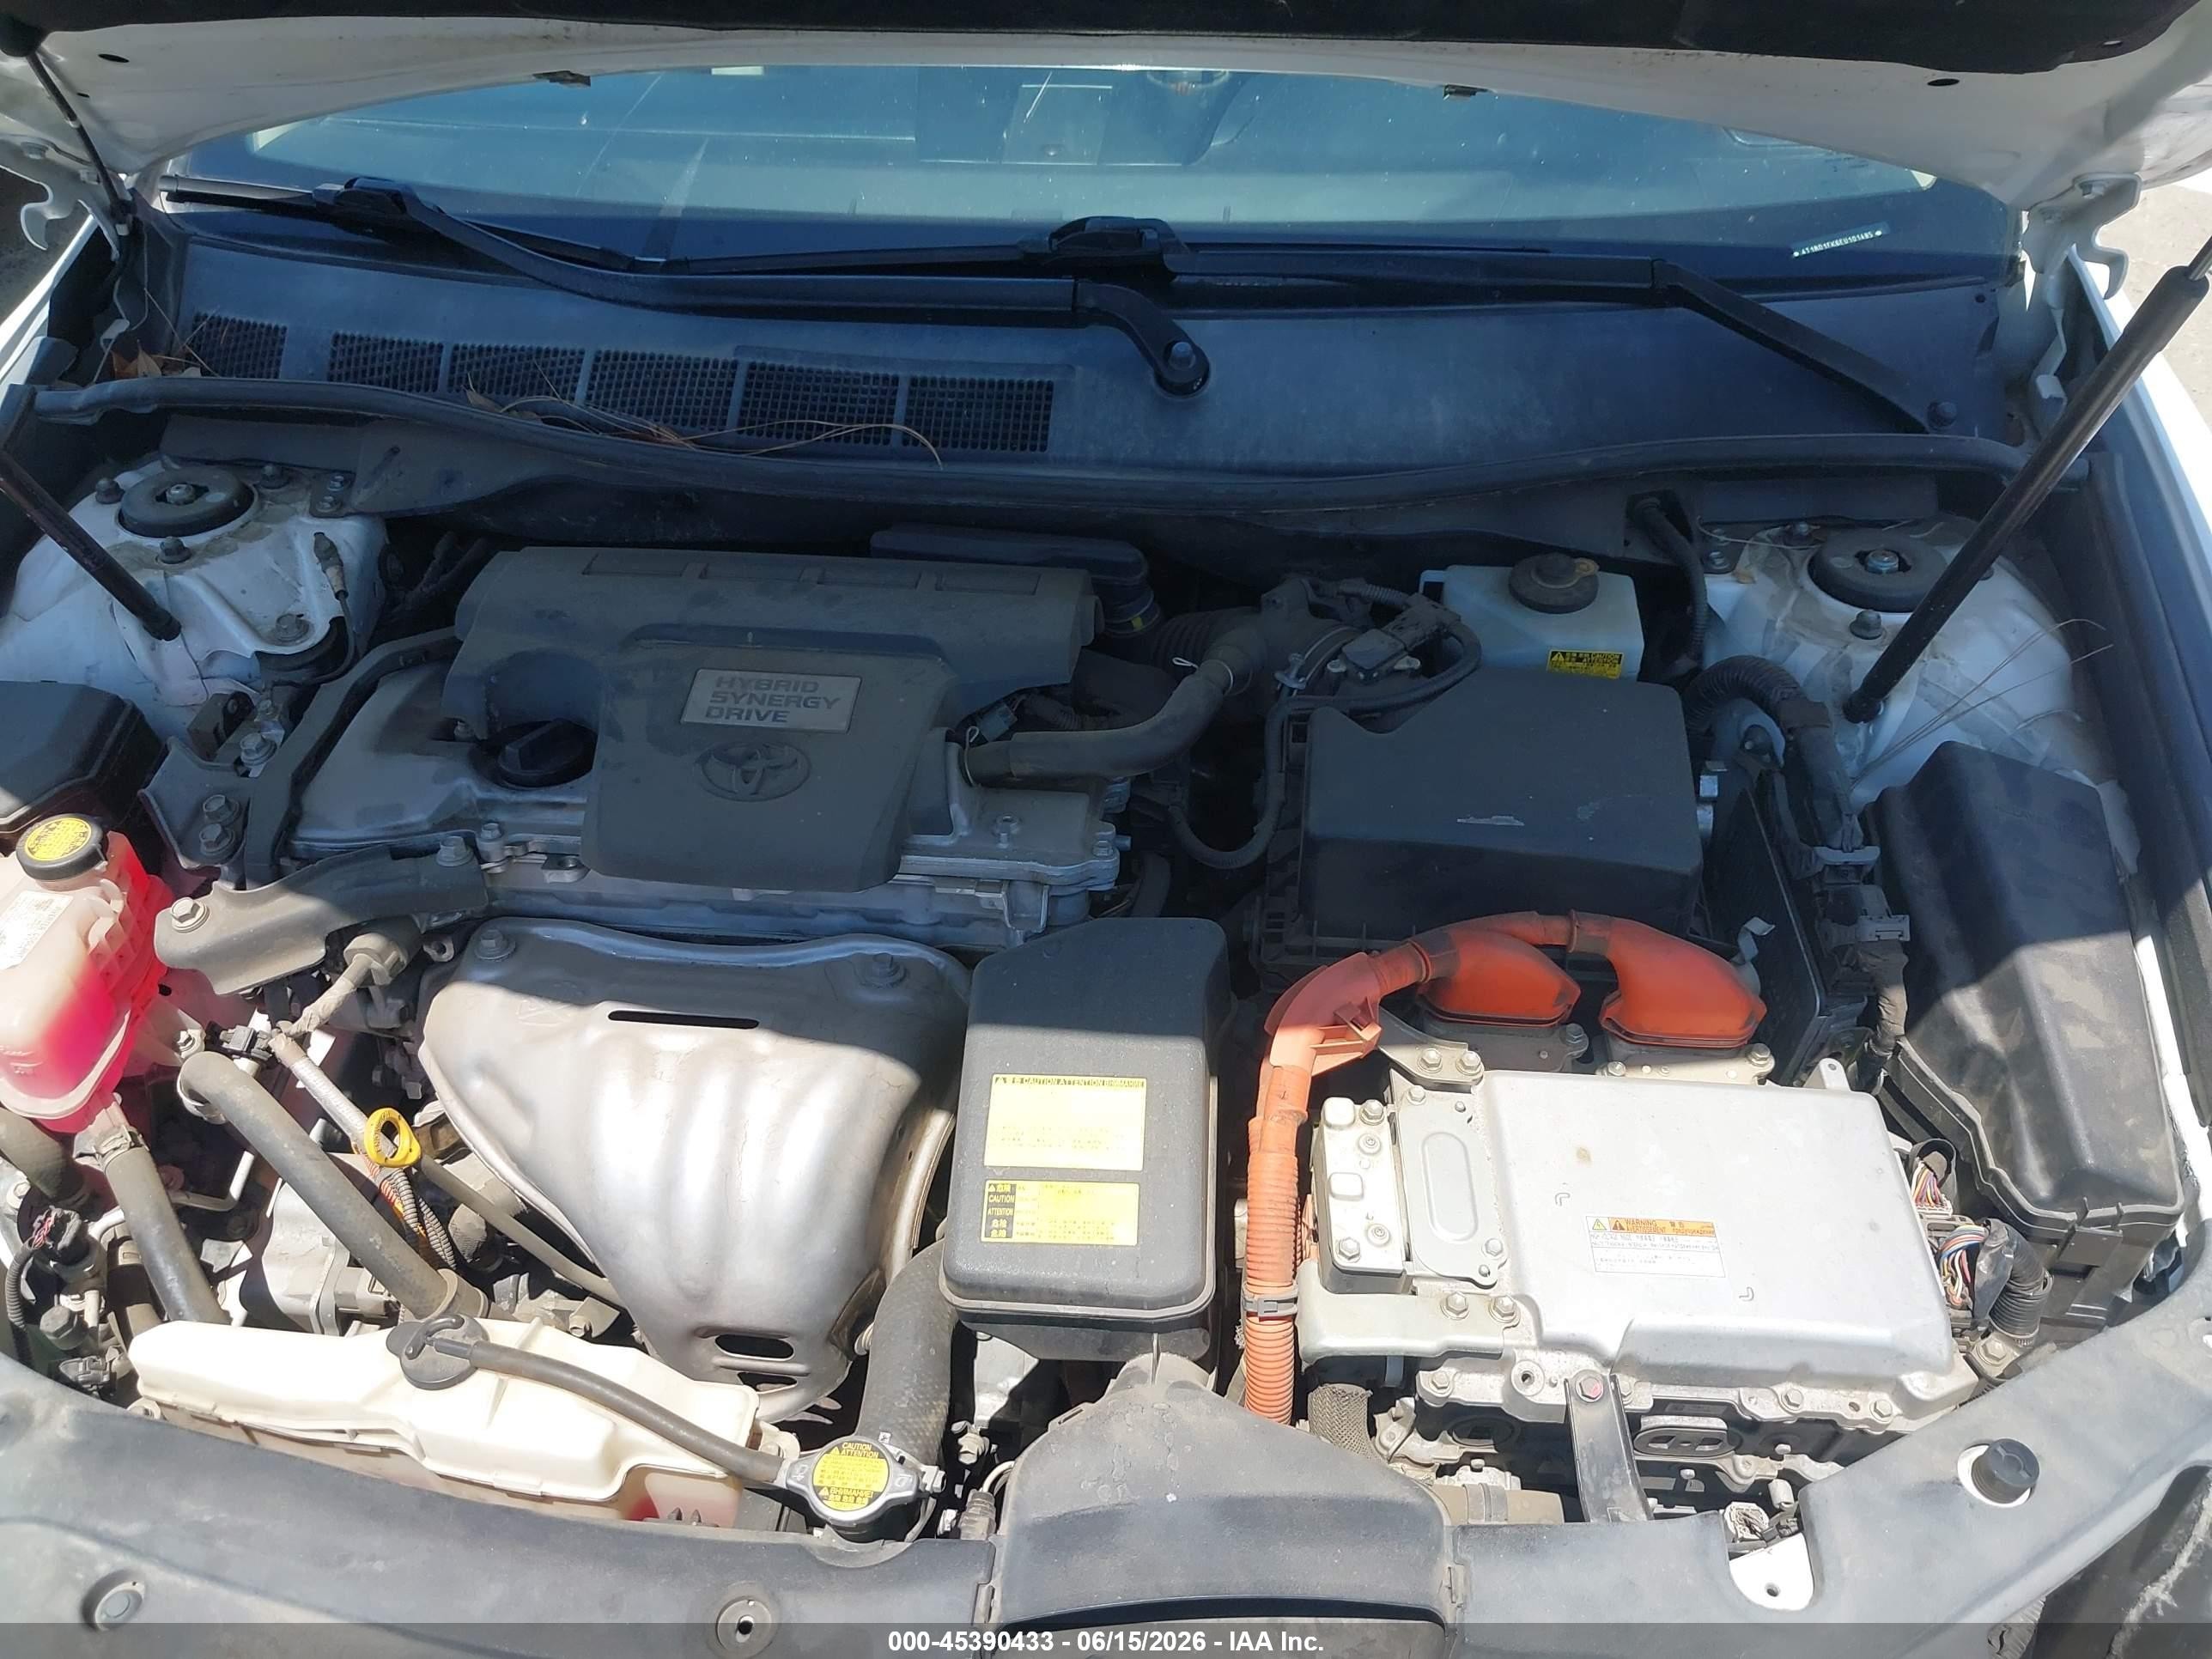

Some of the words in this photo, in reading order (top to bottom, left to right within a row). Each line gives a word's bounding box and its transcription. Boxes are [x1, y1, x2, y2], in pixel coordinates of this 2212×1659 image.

[715, 676, 820, 693] HYBRID
[709, 691, 841, 709] SYNERGY
[705, 707, 790, 723] DRIVE
[988, 1194, 1015, 1203] CAUTION
[988, 1206, 1014, 1216] ATTENTION
[1626, 1218, 1657, 1227] WARNING
[842, 1442, 872, 1451] CAUTION
[841, 1449, 879, 1458] ATTENTION
